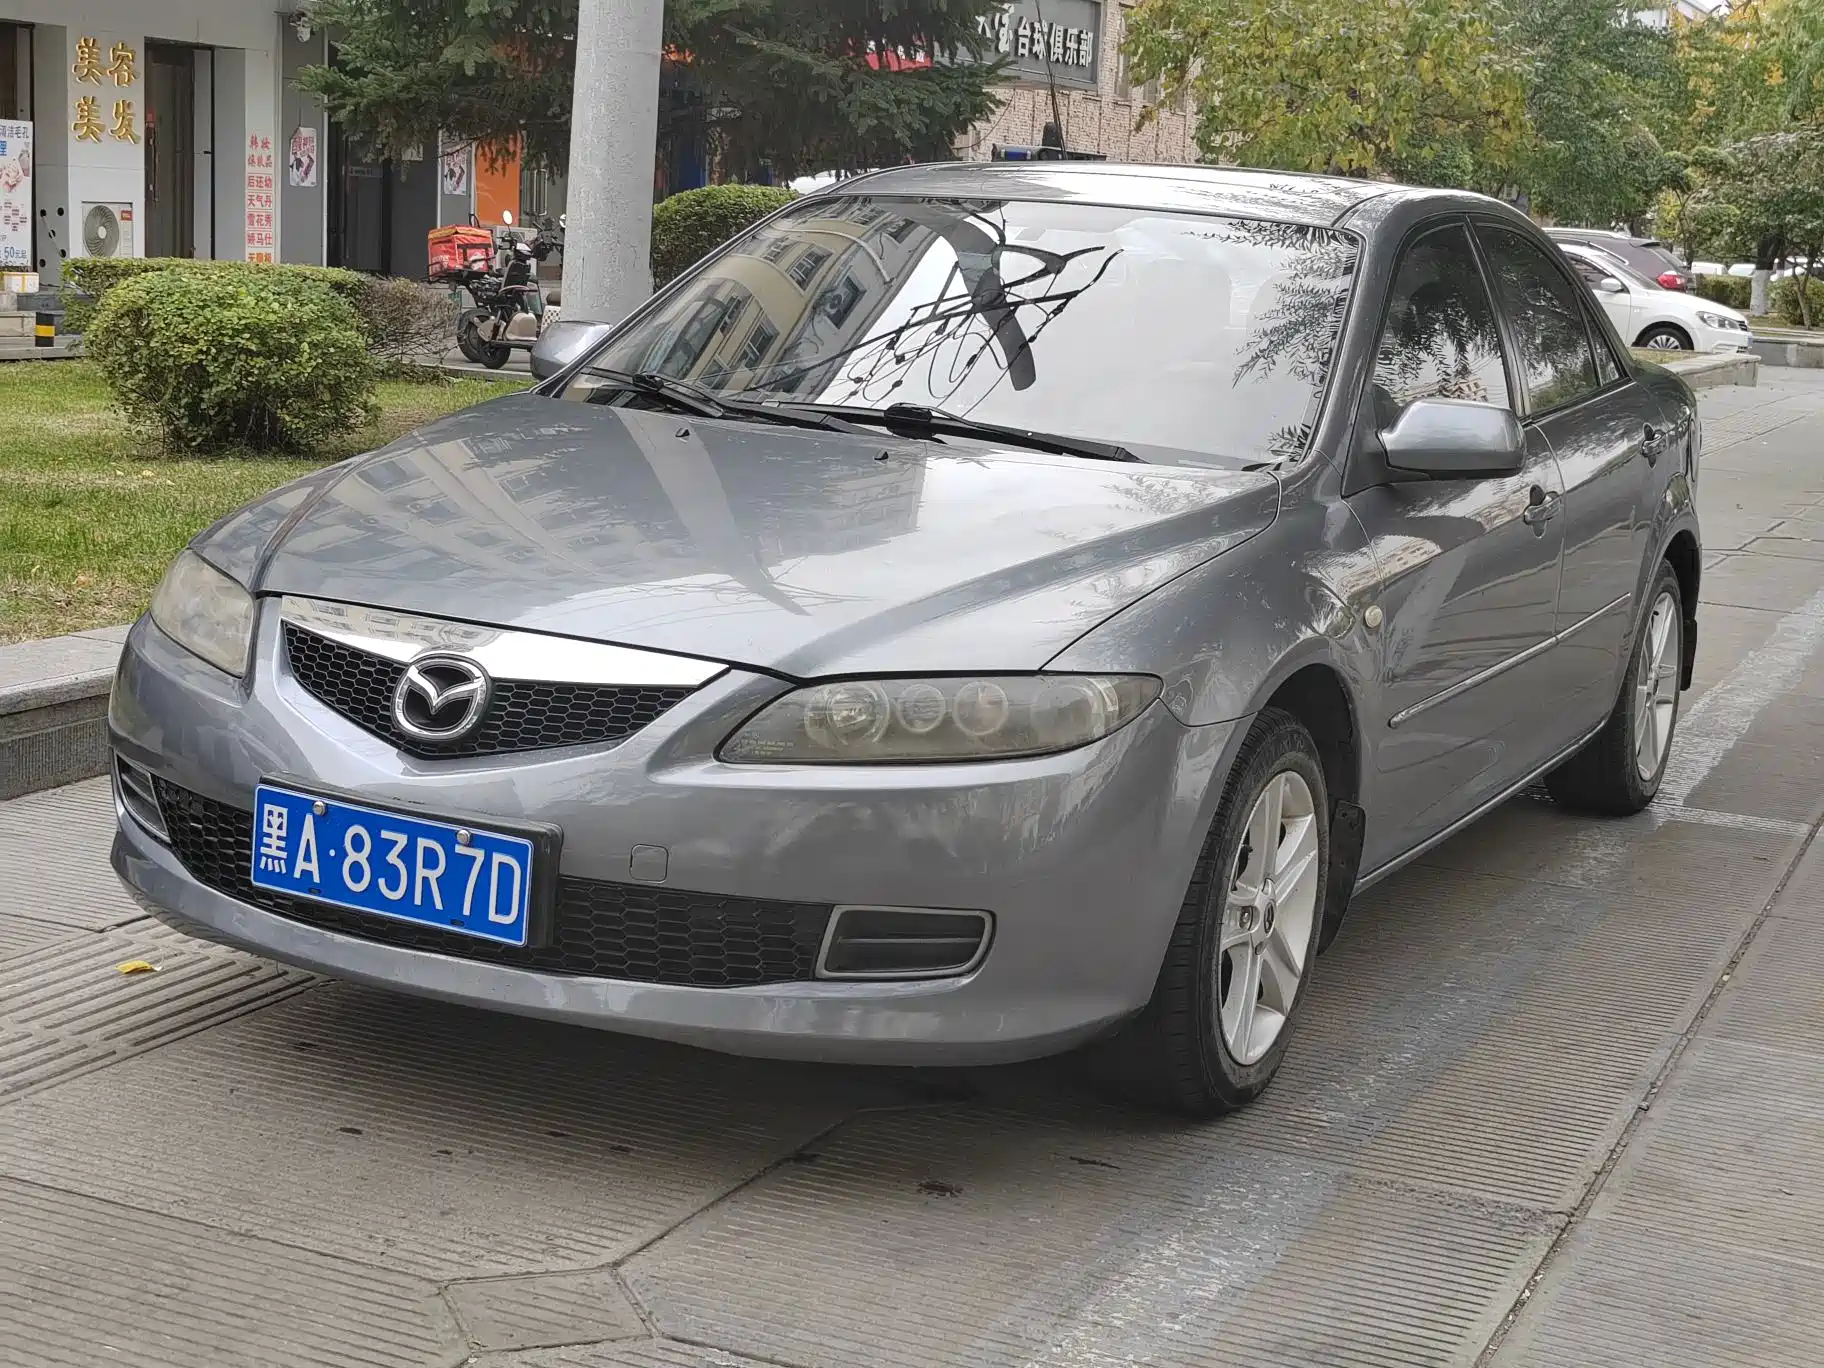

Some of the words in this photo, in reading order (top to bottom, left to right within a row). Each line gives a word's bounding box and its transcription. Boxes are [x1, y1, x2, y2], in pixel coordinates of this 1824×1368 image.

[72, 36, 140, 87] 美容
[1018, 16, 1093, 67] 台球俱乐部
[72, 95, 141, 144] 美发
[259, 803, 521, 925] 黑A·83R7D
